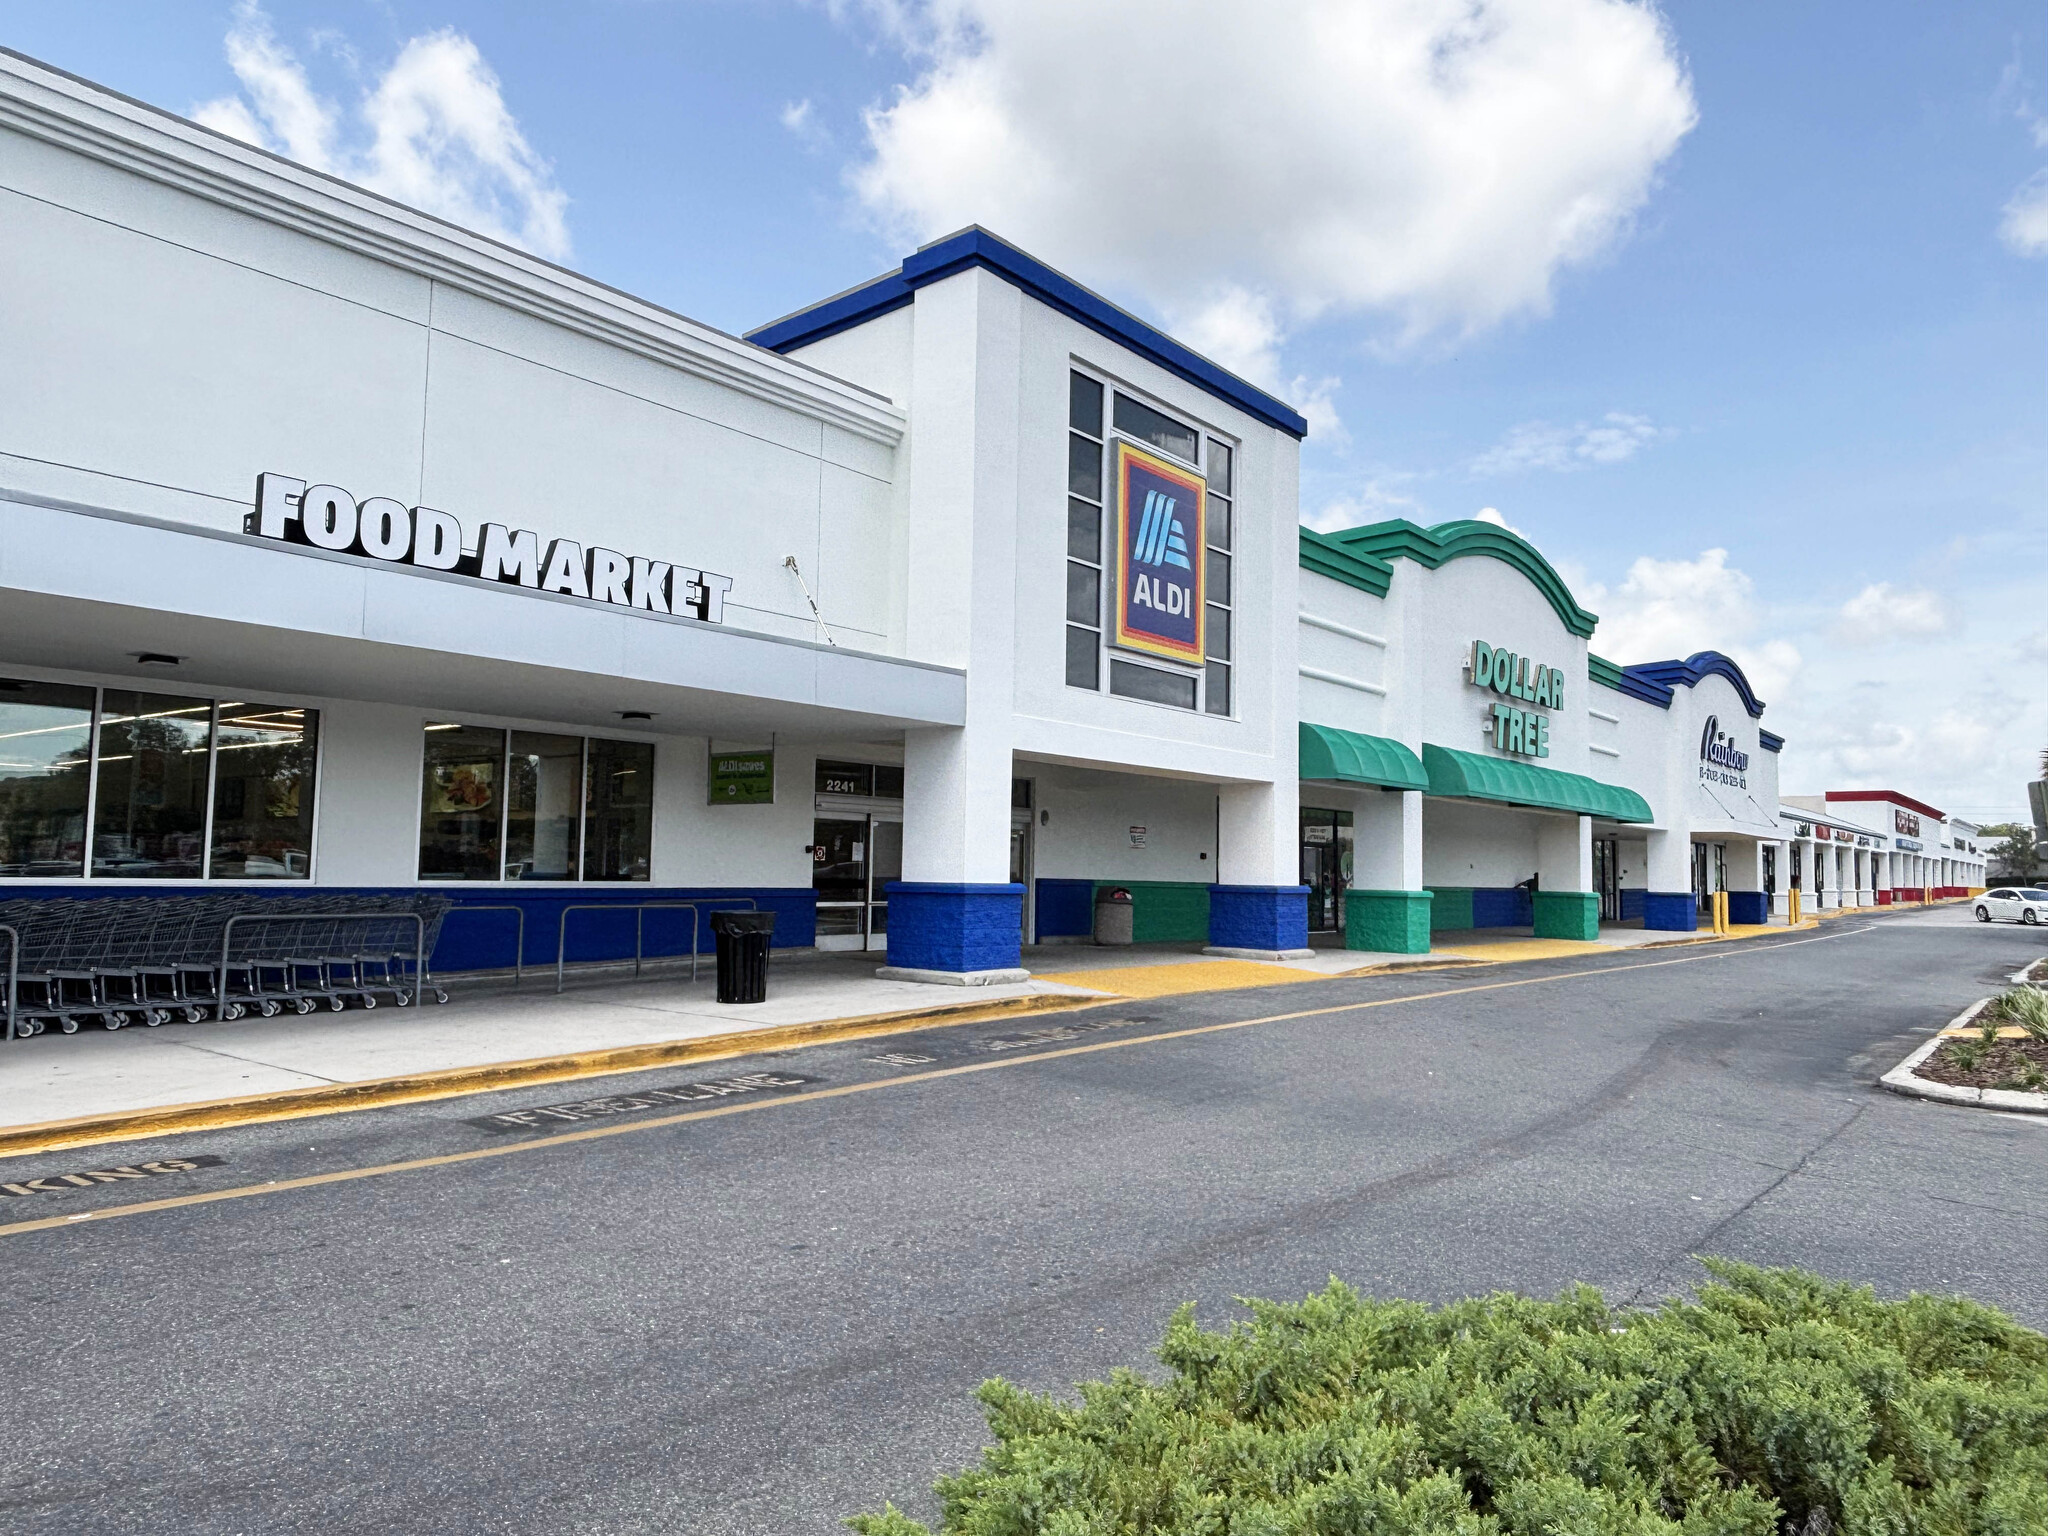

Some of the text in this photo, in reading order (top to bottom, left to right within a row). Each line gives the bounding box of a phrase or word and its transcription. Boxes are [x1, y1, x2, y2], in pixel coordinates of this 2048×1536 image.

[258, 472, 733, 624] FOOD MARKET
[1133, 573, 1191, 619] ALDI
[1473, 639, 1565, 711] DOLLAR
[1491, 702, 1550, 759] TREE
[826, 779, 855, 793] 2241
[654, 1072, 806, 1101] LANE
[0, 1158, 199, 1199] KING
